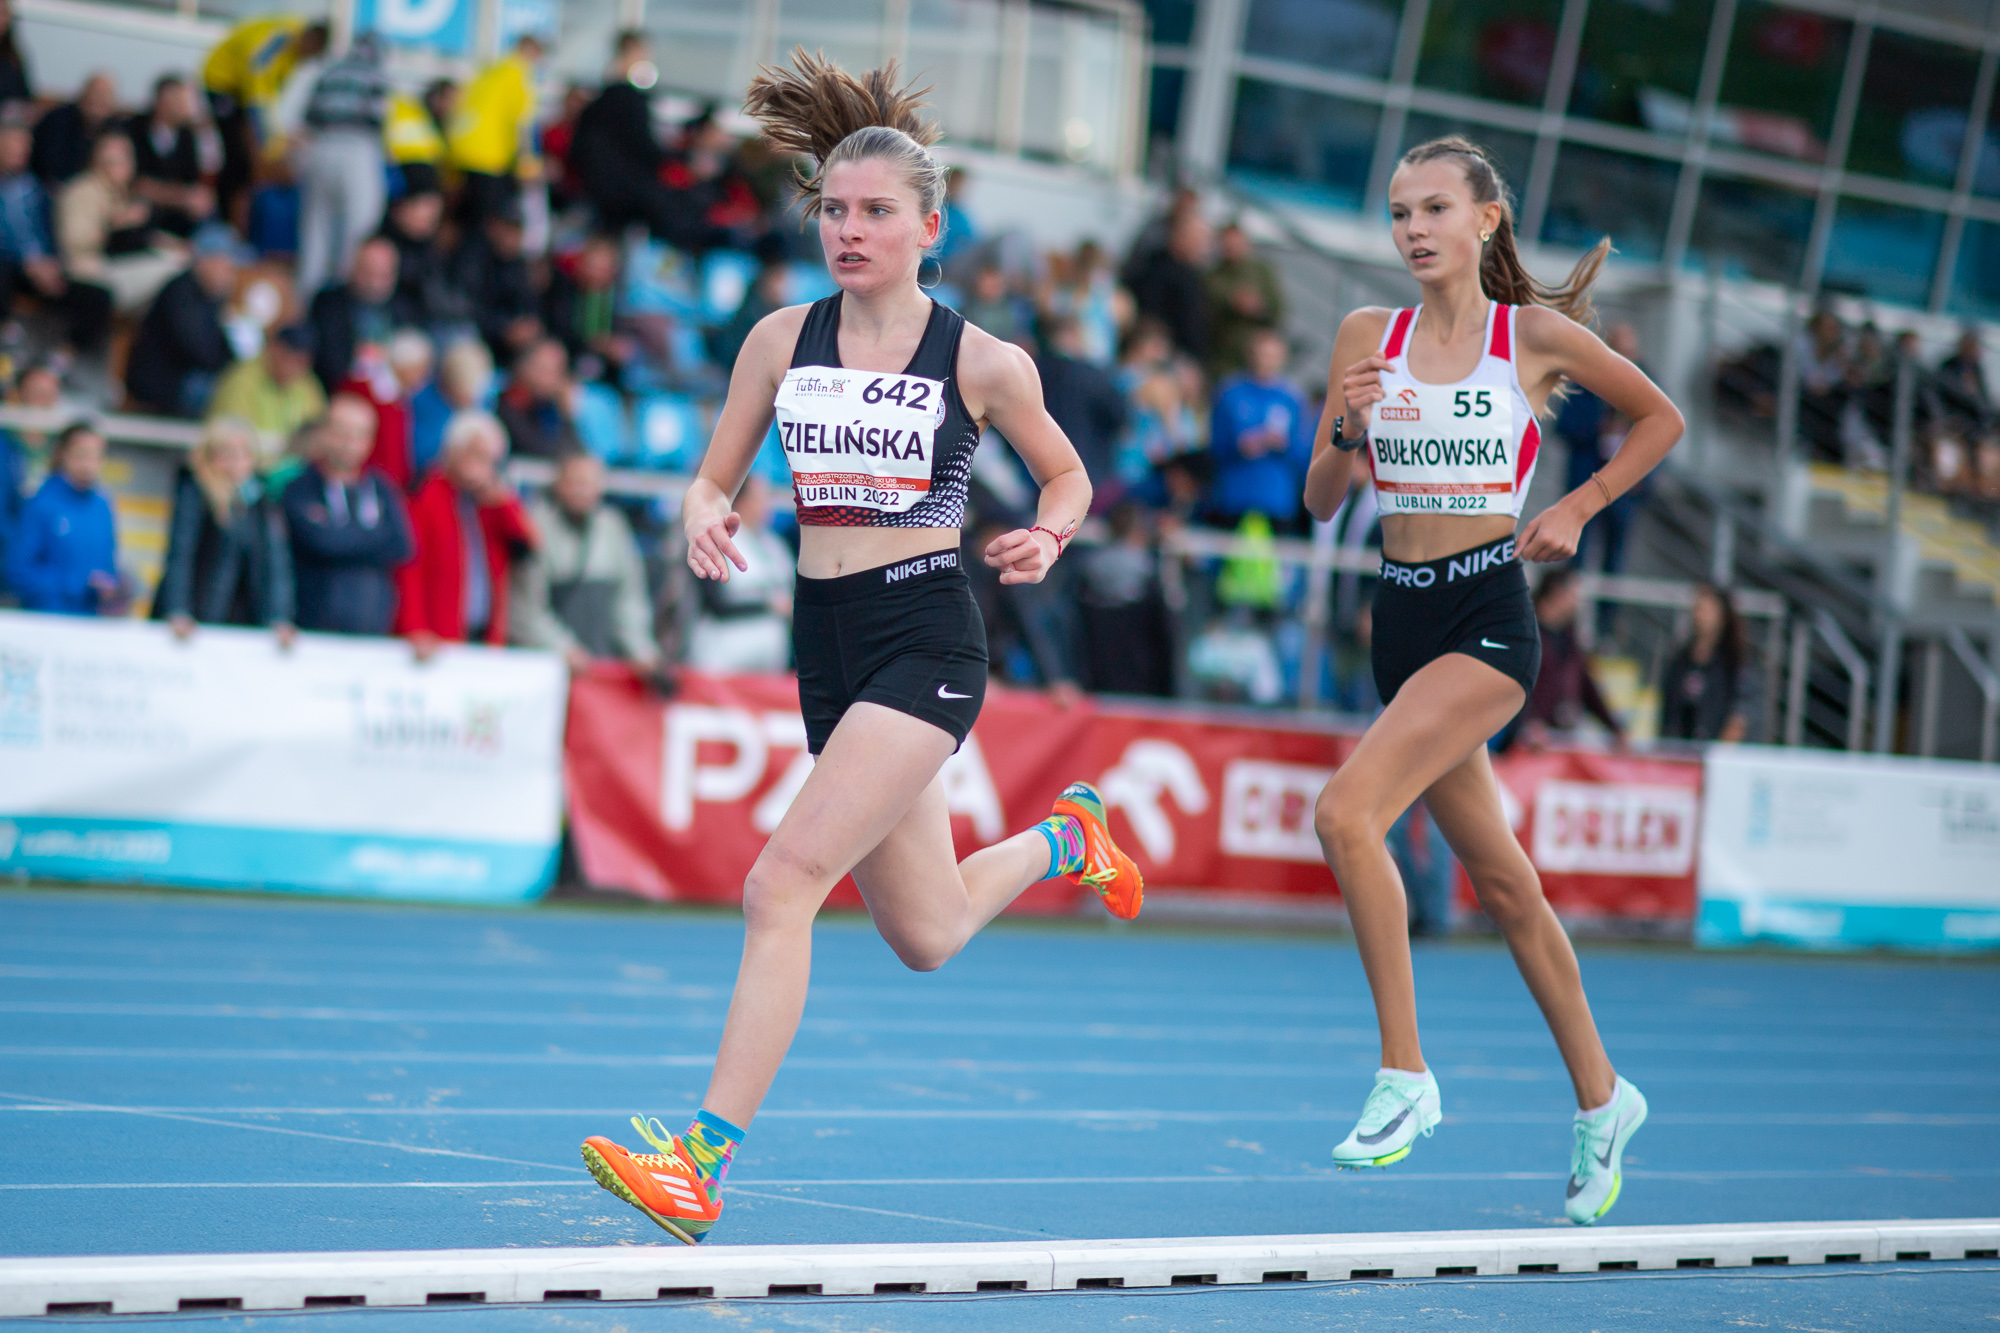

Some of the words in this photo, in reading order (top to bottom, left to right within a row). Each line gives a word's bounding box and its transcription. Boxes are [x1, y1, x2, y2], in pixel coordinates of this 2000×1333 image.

[796, 376, 828, 393] lublin
[862, 377, 931, 411] 642
[1382, 409, 1418, 420] ORLEN
[1453, 391, 1492, 418] 55
[782, 419, 925, 461] ZIELIŃSKA
[1375, 438, 1508, 466] BUŁKOWSKA
[801, 487, 857, 502] LUBLIN
[862, 488, 900, 506] 2022
[1395, 495, 1442, 509] LUBLIN
[1448, 496, 1487, 509] 2022
[886, 559, 927, 584] NIKE
[930, 553, 957, 571] PRO
[1383, 563, 1436, 588] PRO
[1447, 540, 1516, 582] NIKE
